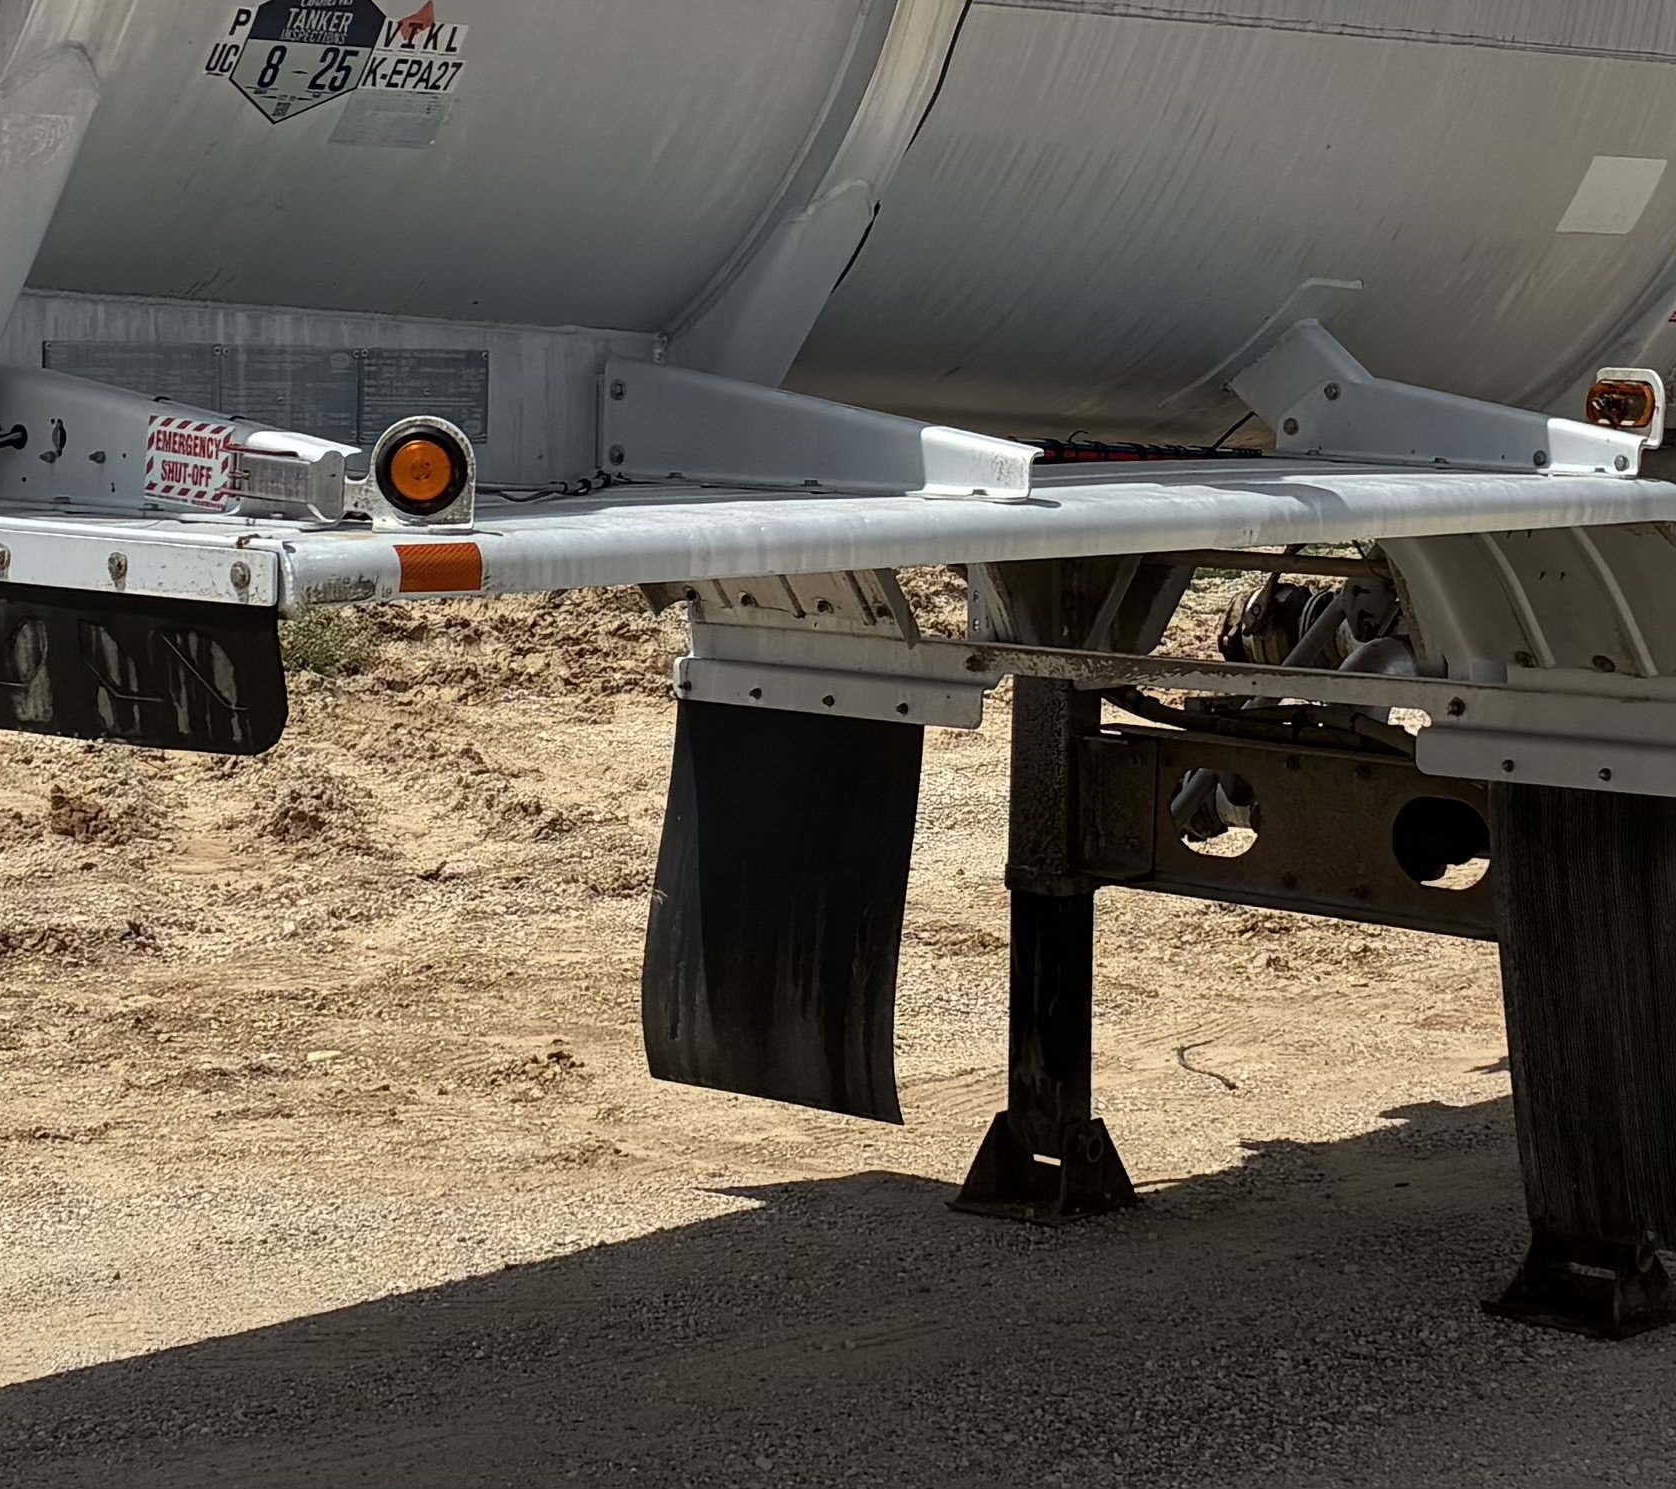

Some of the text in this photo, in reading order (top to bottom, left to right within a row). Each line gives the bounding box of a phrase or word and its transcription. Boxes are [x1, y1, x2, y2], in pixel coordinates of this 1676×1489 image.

[228, 8, 252, 36] P
[286, 8, 354, 33] TANKER
[279, 28, 348, 45] INSPECTIONS
[205, 43, 240, 73] UC
[257, 45, 288, 88] 8
[307, 47, 360, 92] 25
[361, 56, 463, 91] K-EPA27
[155, 430, 221, 460] EMERGENCY
[160, 460, 213, 487] SHUT-OFF
